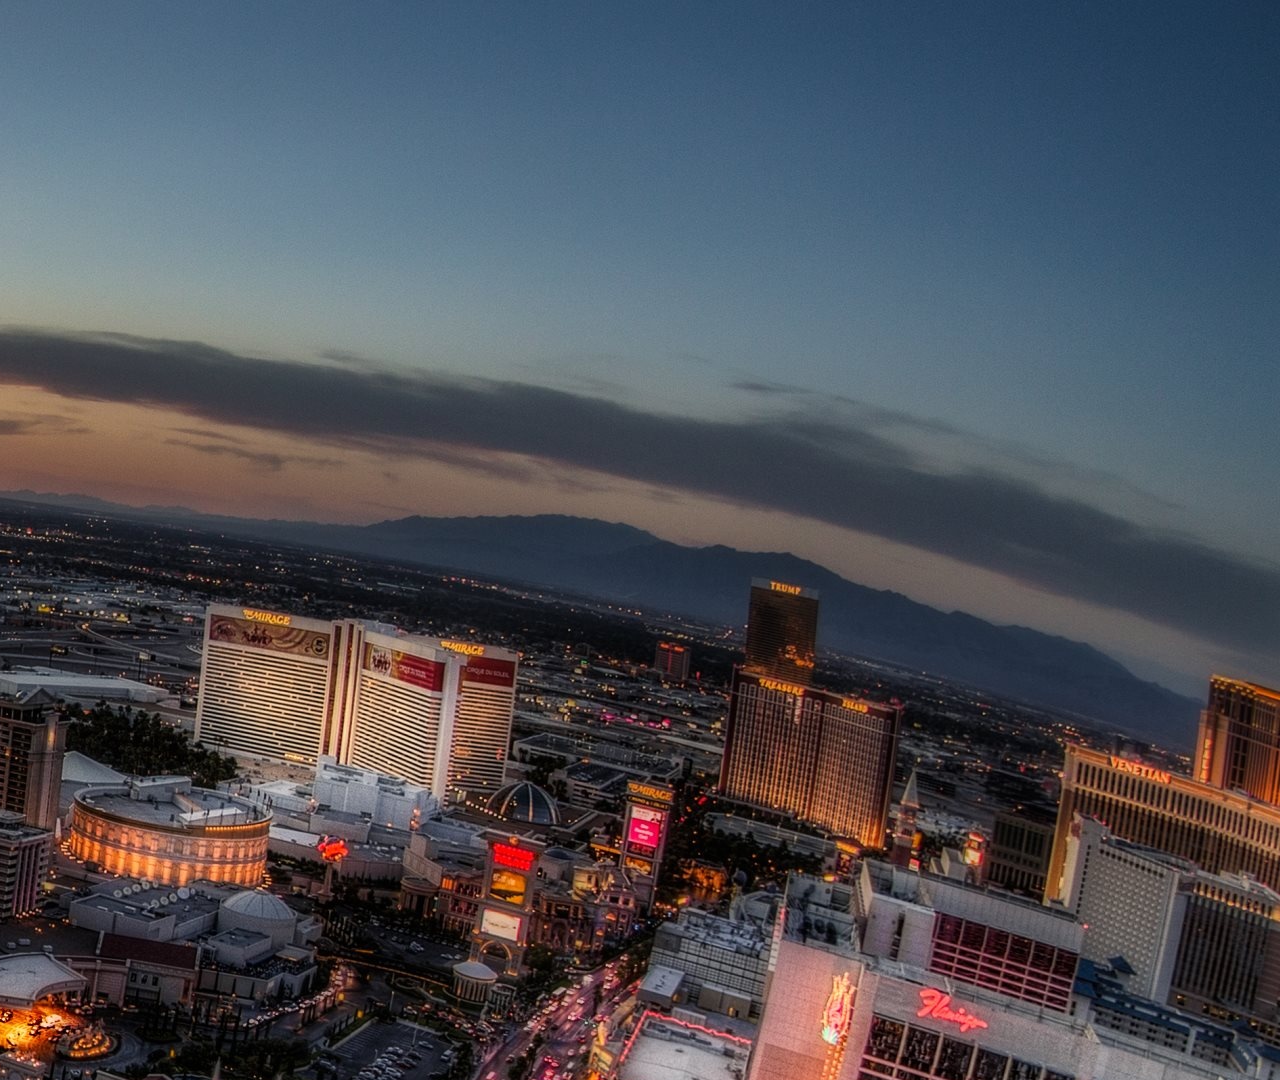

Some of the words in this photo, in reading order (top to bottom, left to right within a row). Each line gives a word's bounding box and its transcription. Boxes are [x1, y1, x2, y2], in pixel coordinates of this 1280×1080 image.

[770, 582, 801, 595] TRUMP
[247, 611, 291, 625] MIRAGE
[448, 643, 484, 655] MIRAGE
[759, 678, 805, 696] TREASURE
[842, 698, 869, 713] ISLAND
[1110, 755, 1172, 784] VENETIAN
[1200, 739, 1212, 784] PALA
[633, 785, 672, 800] MIRAGE
[916, 987, 988, 1032] Flamingo
